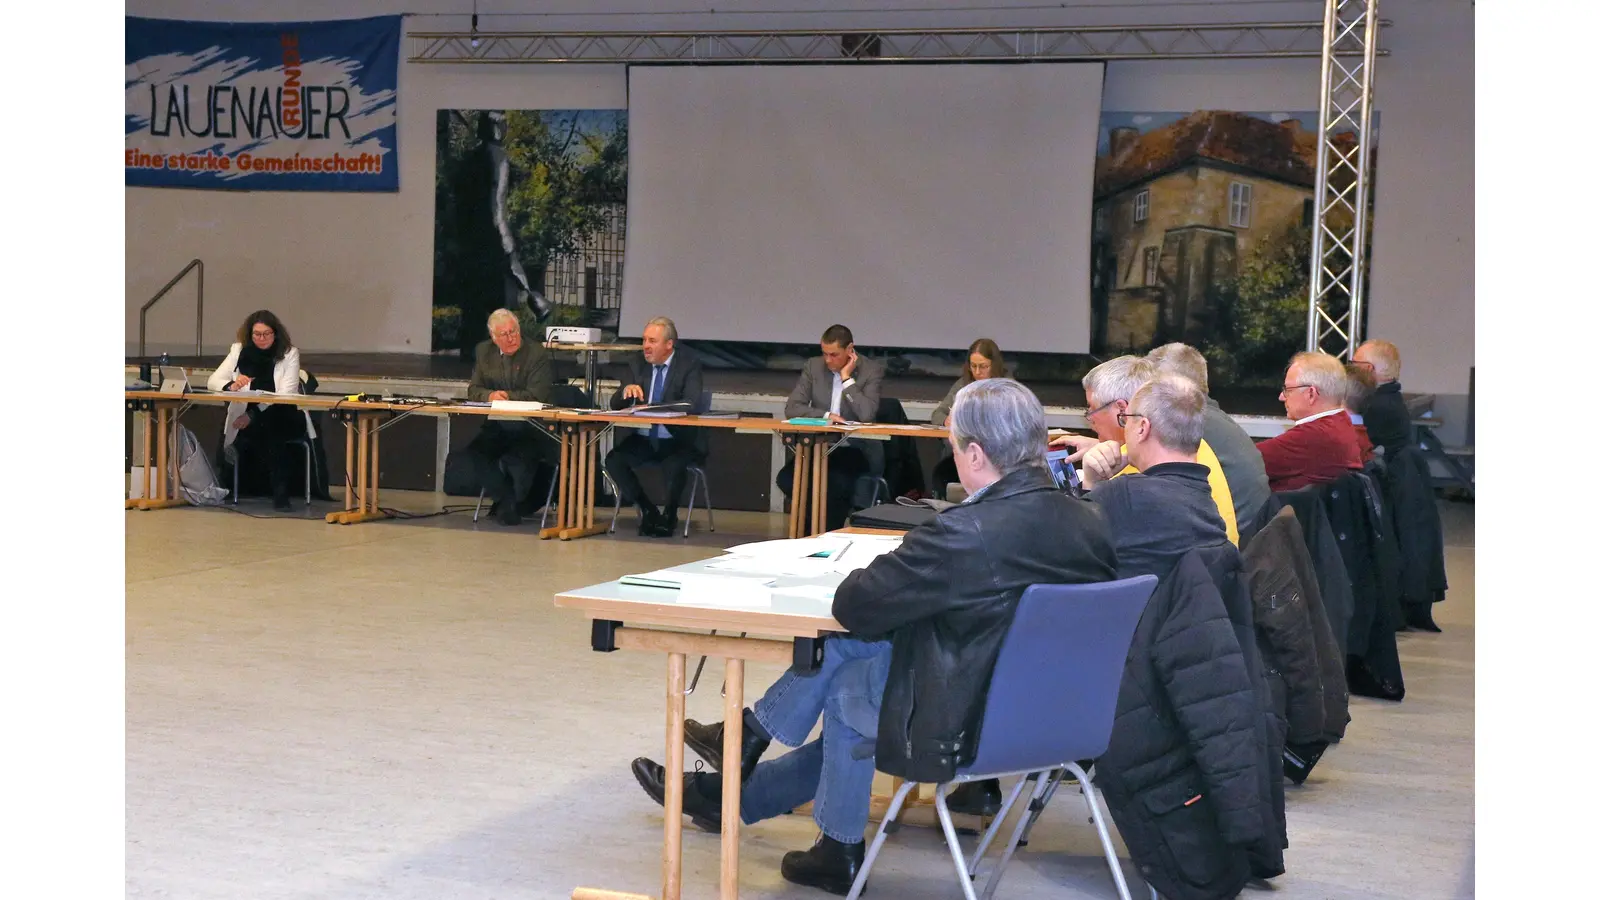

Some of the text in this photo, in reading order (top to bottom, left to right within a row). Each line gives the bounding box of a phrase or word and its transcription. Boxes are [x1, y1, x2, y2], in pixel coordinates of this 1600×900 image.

[282, 32, 302, 127] RUNDE
[150, 84, 350, 139] LAUENAUER
[125, 148, 382, 173] Eine starke Gemeinschaft!
